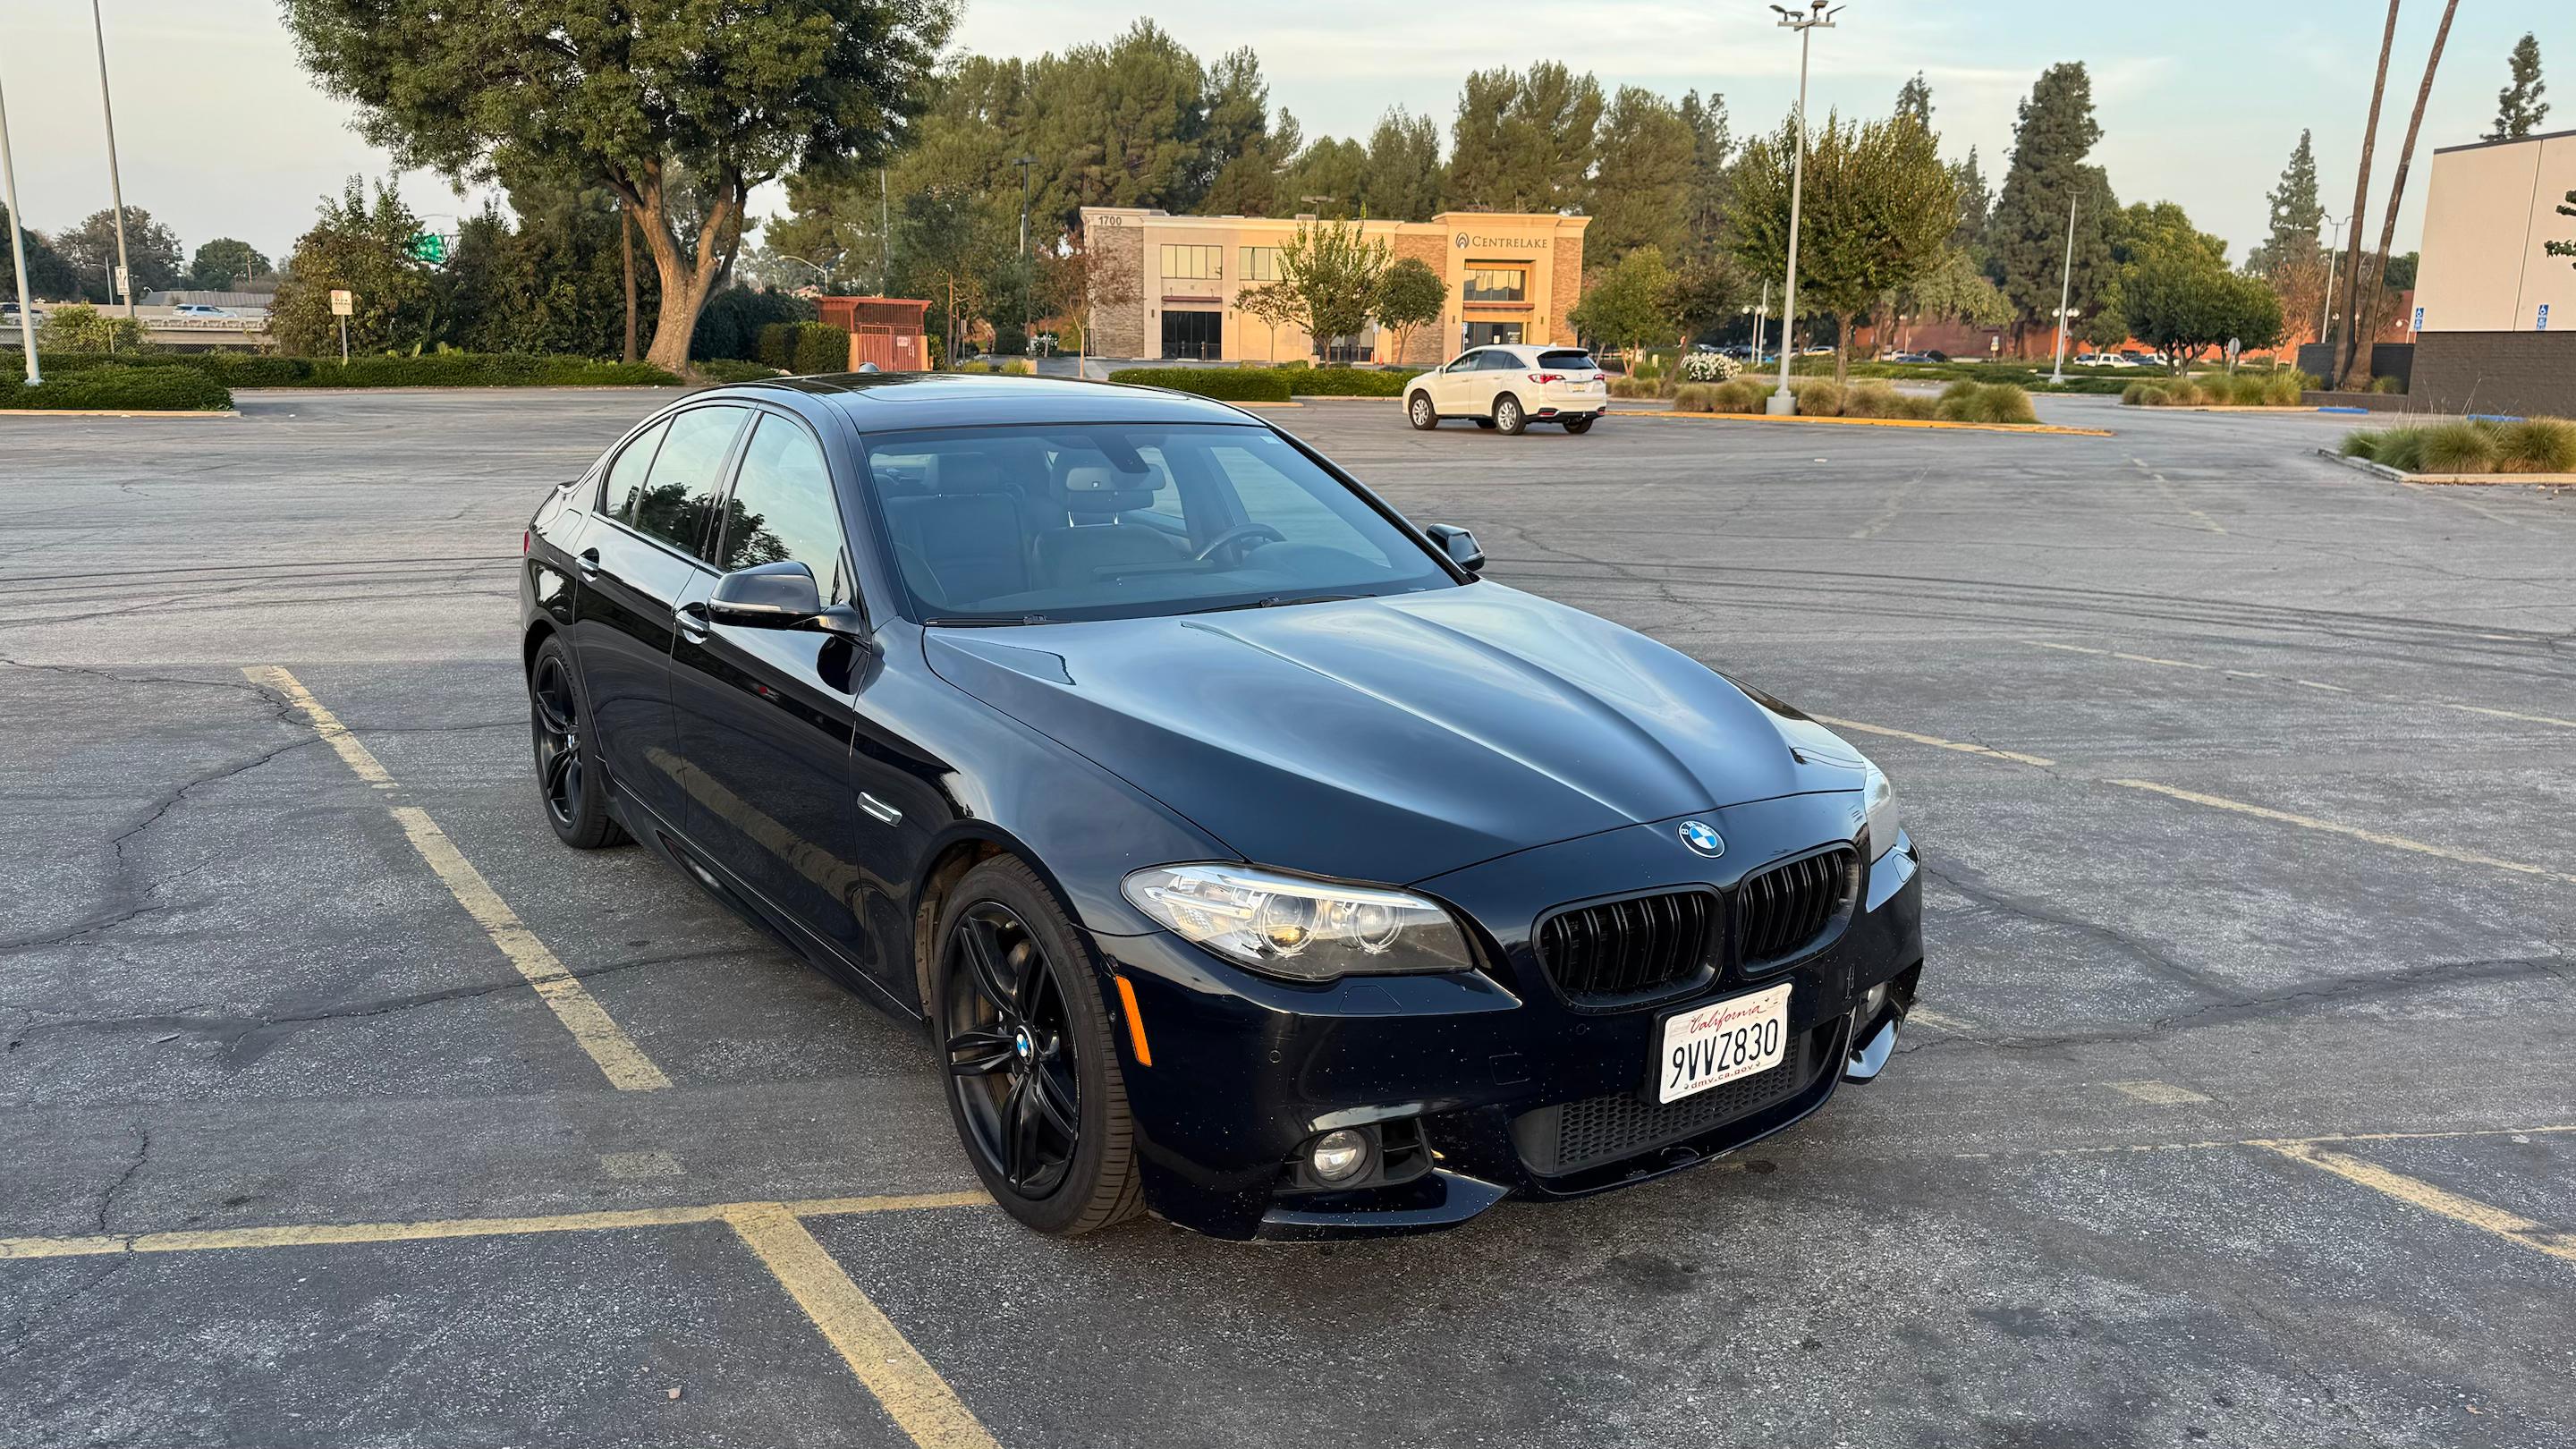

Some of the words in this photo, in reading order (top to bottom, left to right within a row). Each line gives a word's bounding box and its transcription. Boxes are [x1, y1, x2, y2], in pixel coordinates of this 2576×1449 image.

[1099, 216, 1122, 225] 1700
[1472, 235, 1547, 249] CENTRELAKE
[1690, 1002, 1767, 1034] California
[1670, 1019, 1778, 1089] 9VVZ830
[1691, 1063, 1754, 1089] dmv.ca.gov
